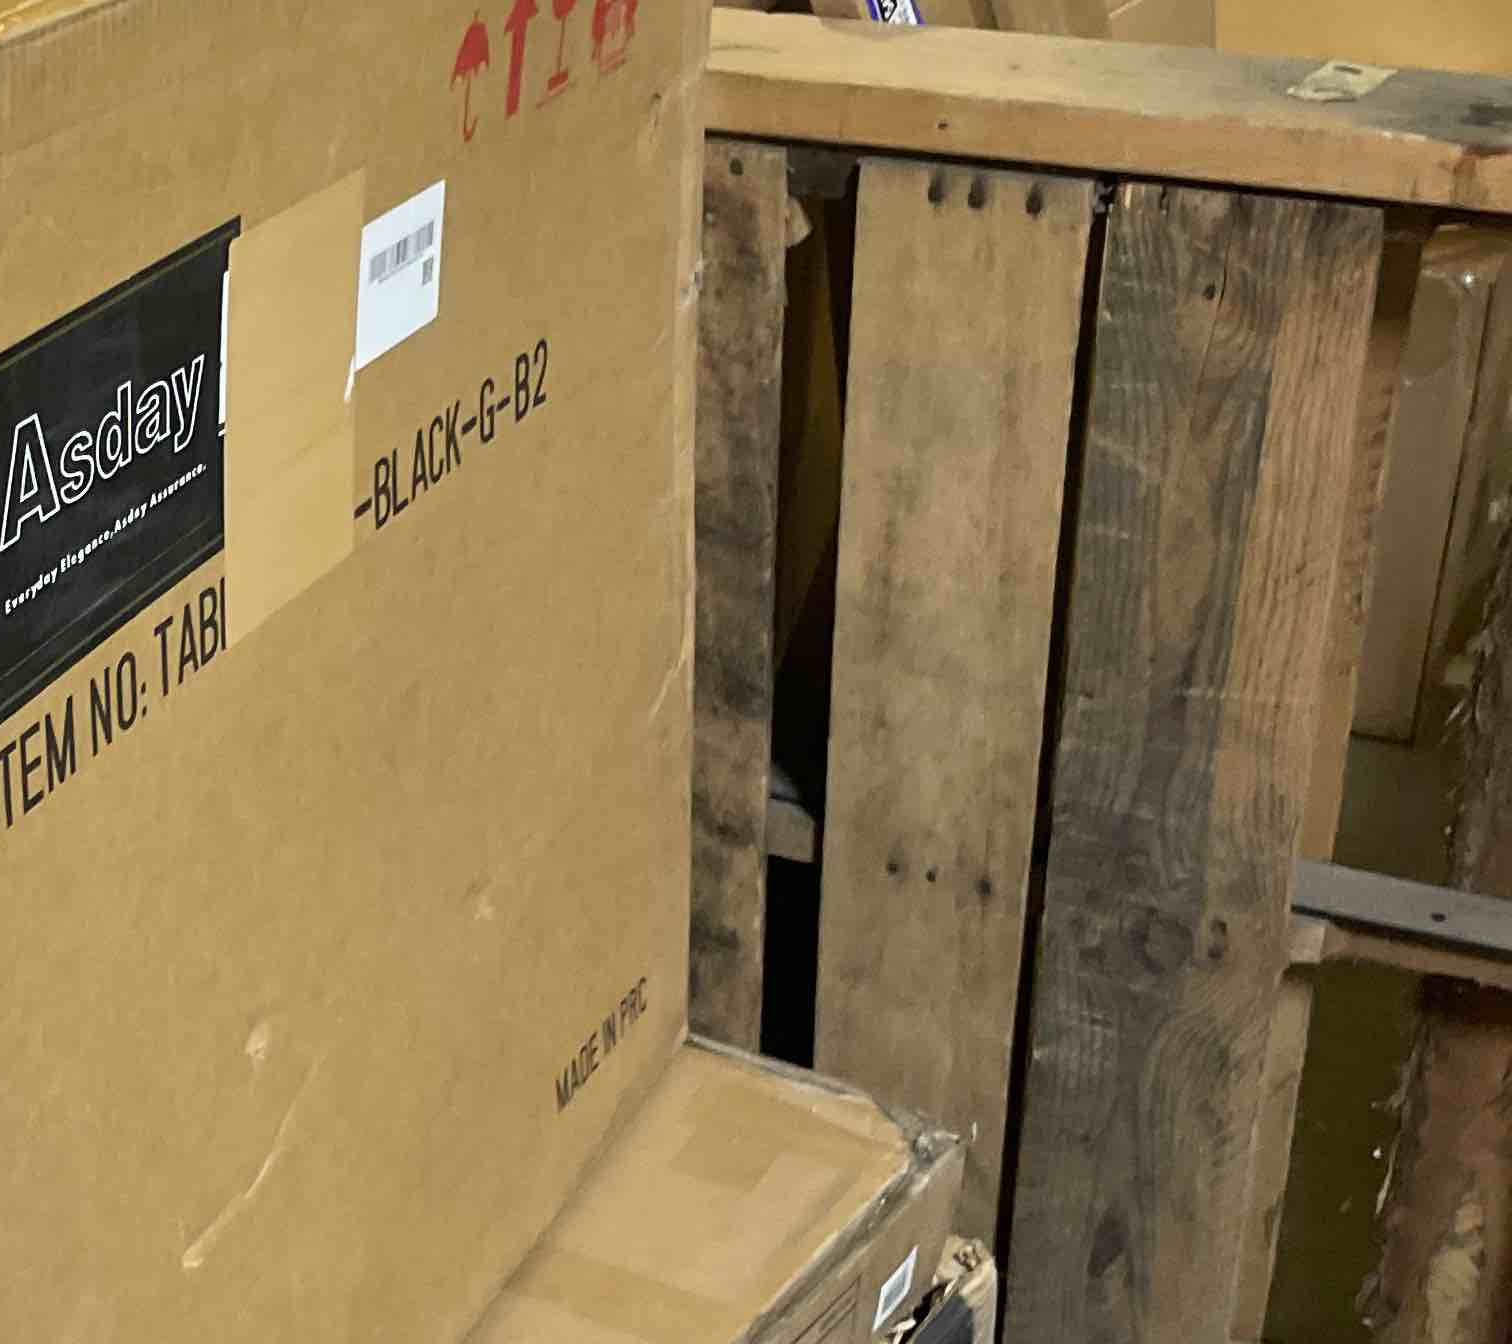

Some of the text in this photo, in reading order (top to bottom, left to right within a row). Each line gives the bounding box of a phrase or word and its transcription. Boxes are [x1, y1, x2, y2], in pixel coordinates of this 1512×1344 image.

[0, 353, 205, 553] Asday
[4, 567, 58, 616] Everyday
[555, 1031, 600, 1114] MADE
[601, 1011, 616, 1055] IN
